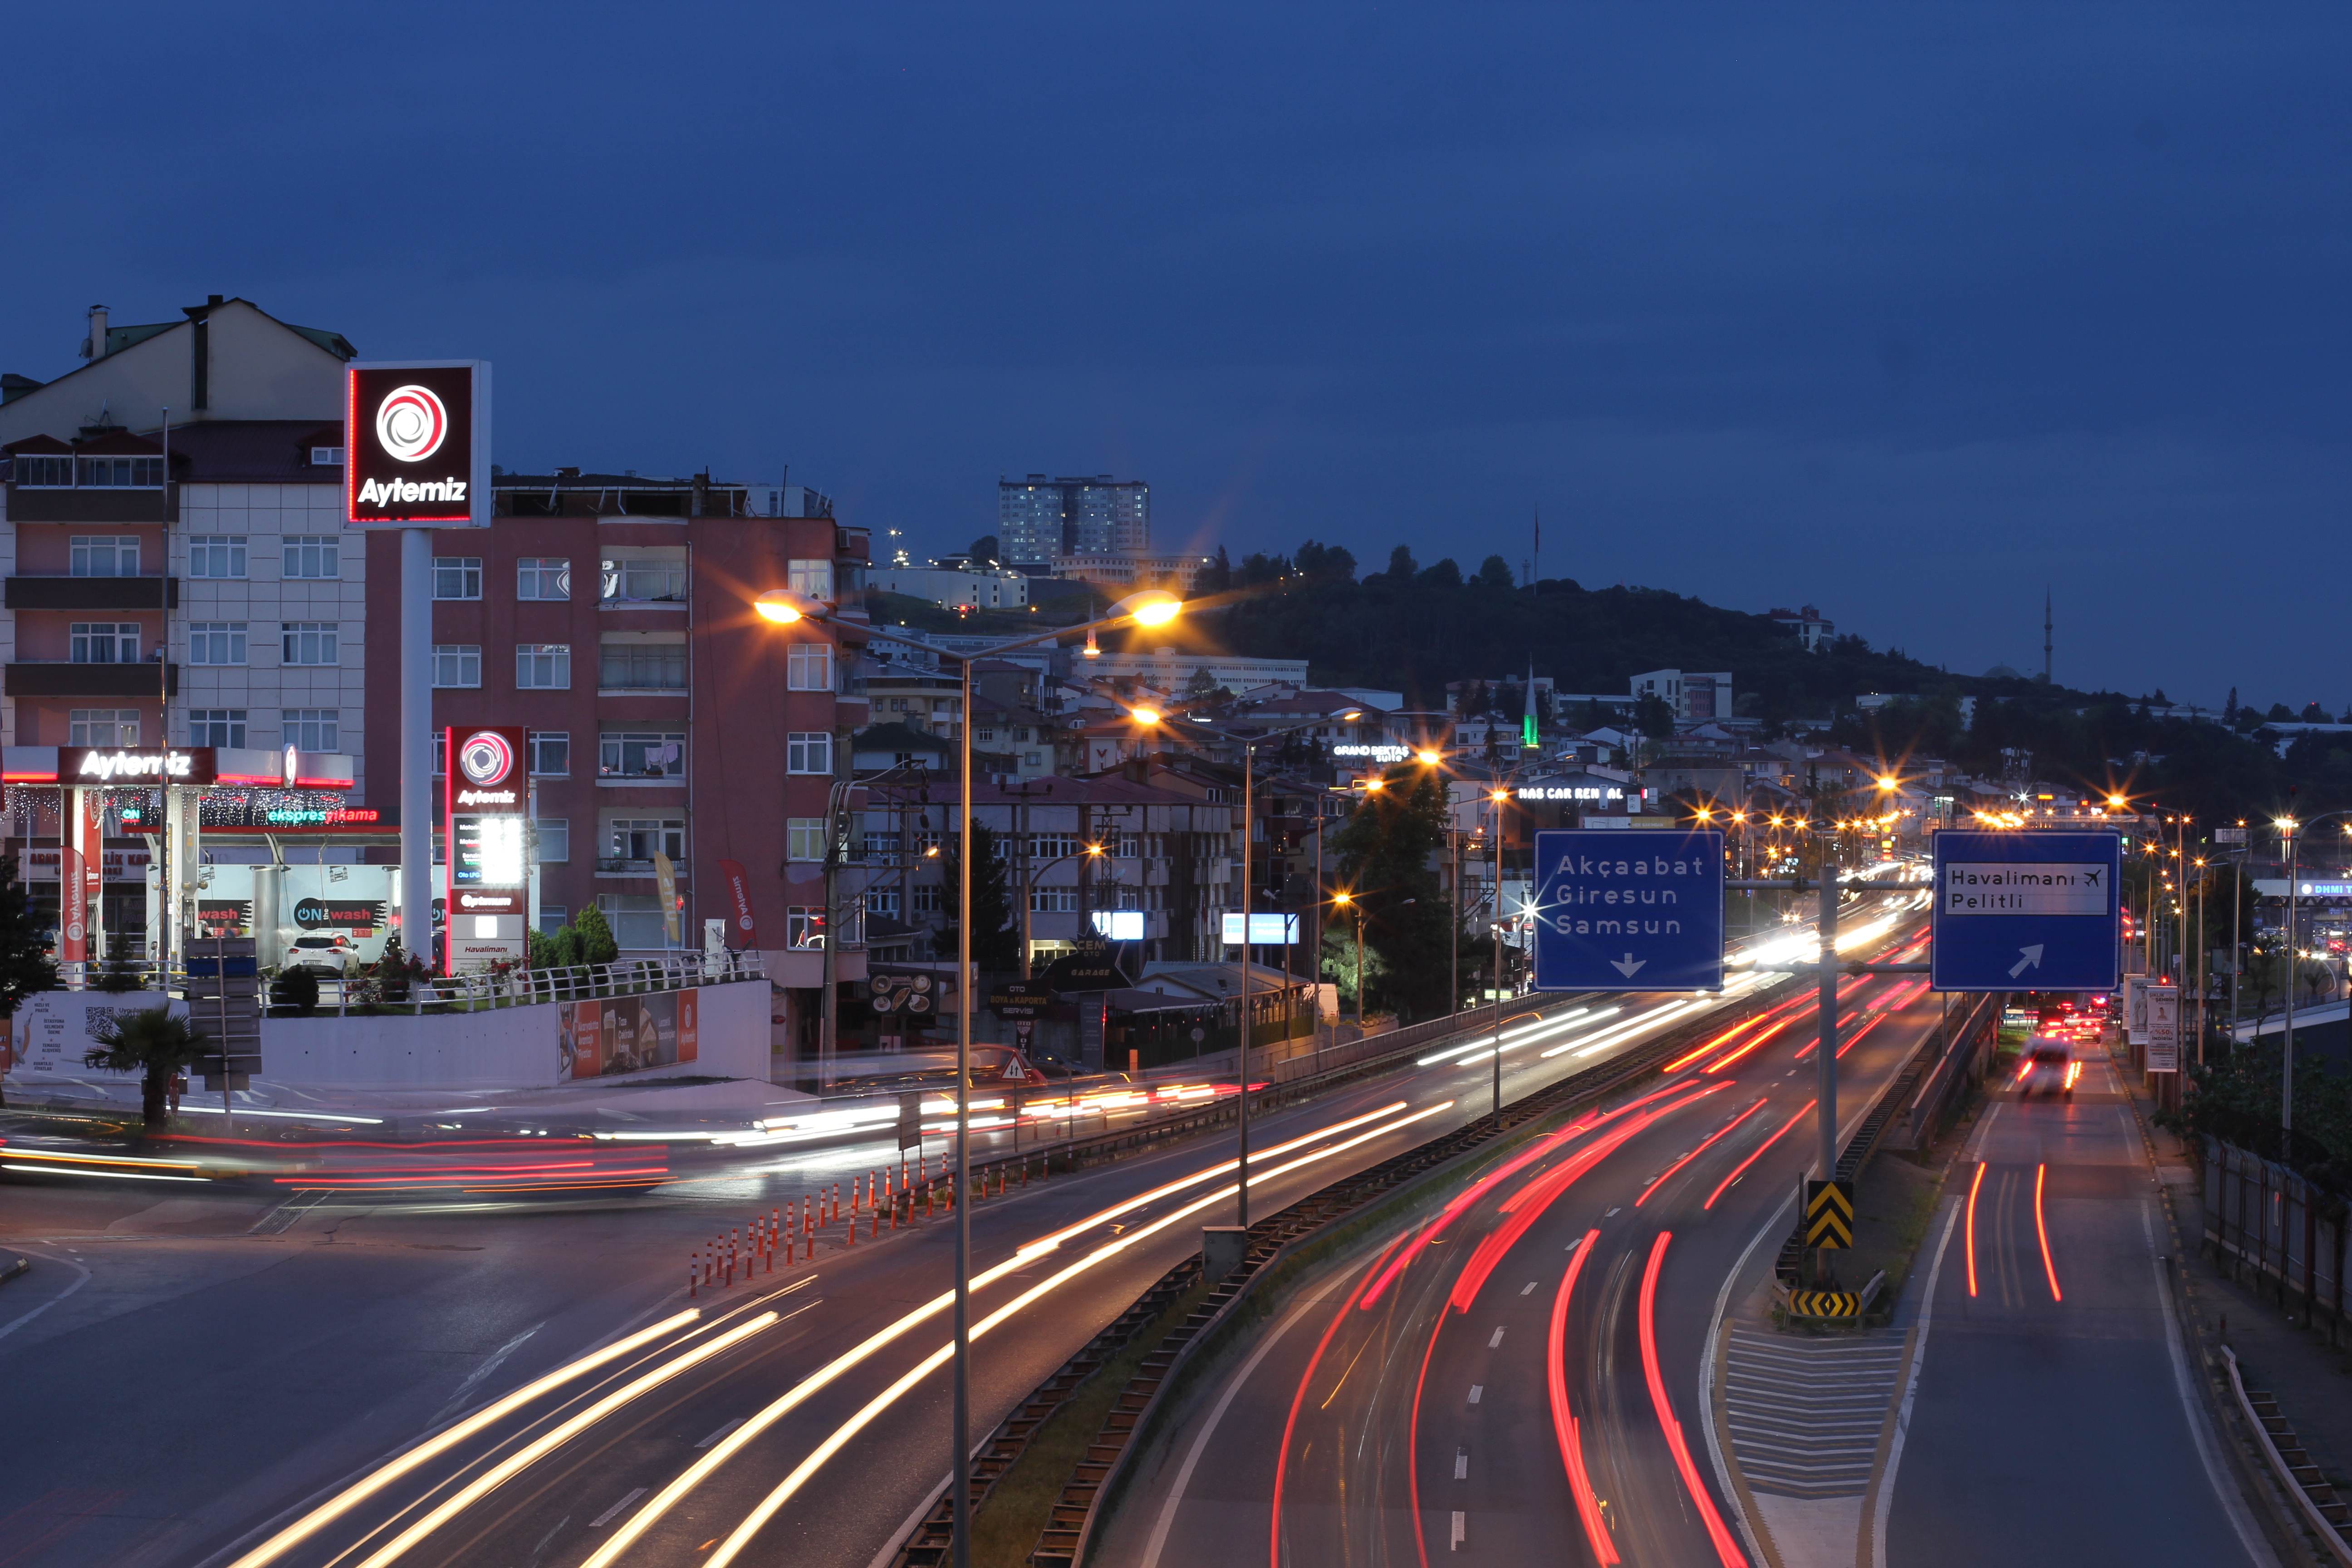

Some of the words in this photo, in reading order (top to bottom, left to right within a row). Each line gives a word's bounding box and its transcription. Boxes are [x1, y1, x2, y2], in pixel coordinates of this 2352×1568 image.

[357, 476, 467, 508] Aytemiz
[1334, 745, 1370, 755] GRAND
[1371, 746, 1409, 757] BEKTAŞ
[80, 751, 191, 779] Aytemiz
[457, 789, 516, 806] Aytemiz
[1519, 788, 1544, 799] NAS
[1547, 788, 1573, 799] CAR
[1575, 788, 1623, 799] RENAL
[128, 854, 151, 865] KAP
[1557, 855, 1702, 877] Akçaabat
[1952, 870, 2074, 885] Havalimanı
[1557, 885, 1677, 904] Giresun
[1952, 893, 2022, 908] Pelitli
[199, 908, 237, 920] wash
[298, 907, 321, 921] ON
[331, 909, 371, 920] wash
[1557, 915, 1680, 934] Samsun
[1077, 940, 1106, 951] CEM
[990, 995, 1008, 1004] BOYA
[618, 1017, 627, 1026] Taze
[681, 1032, 695, 1045] Aytemiz
